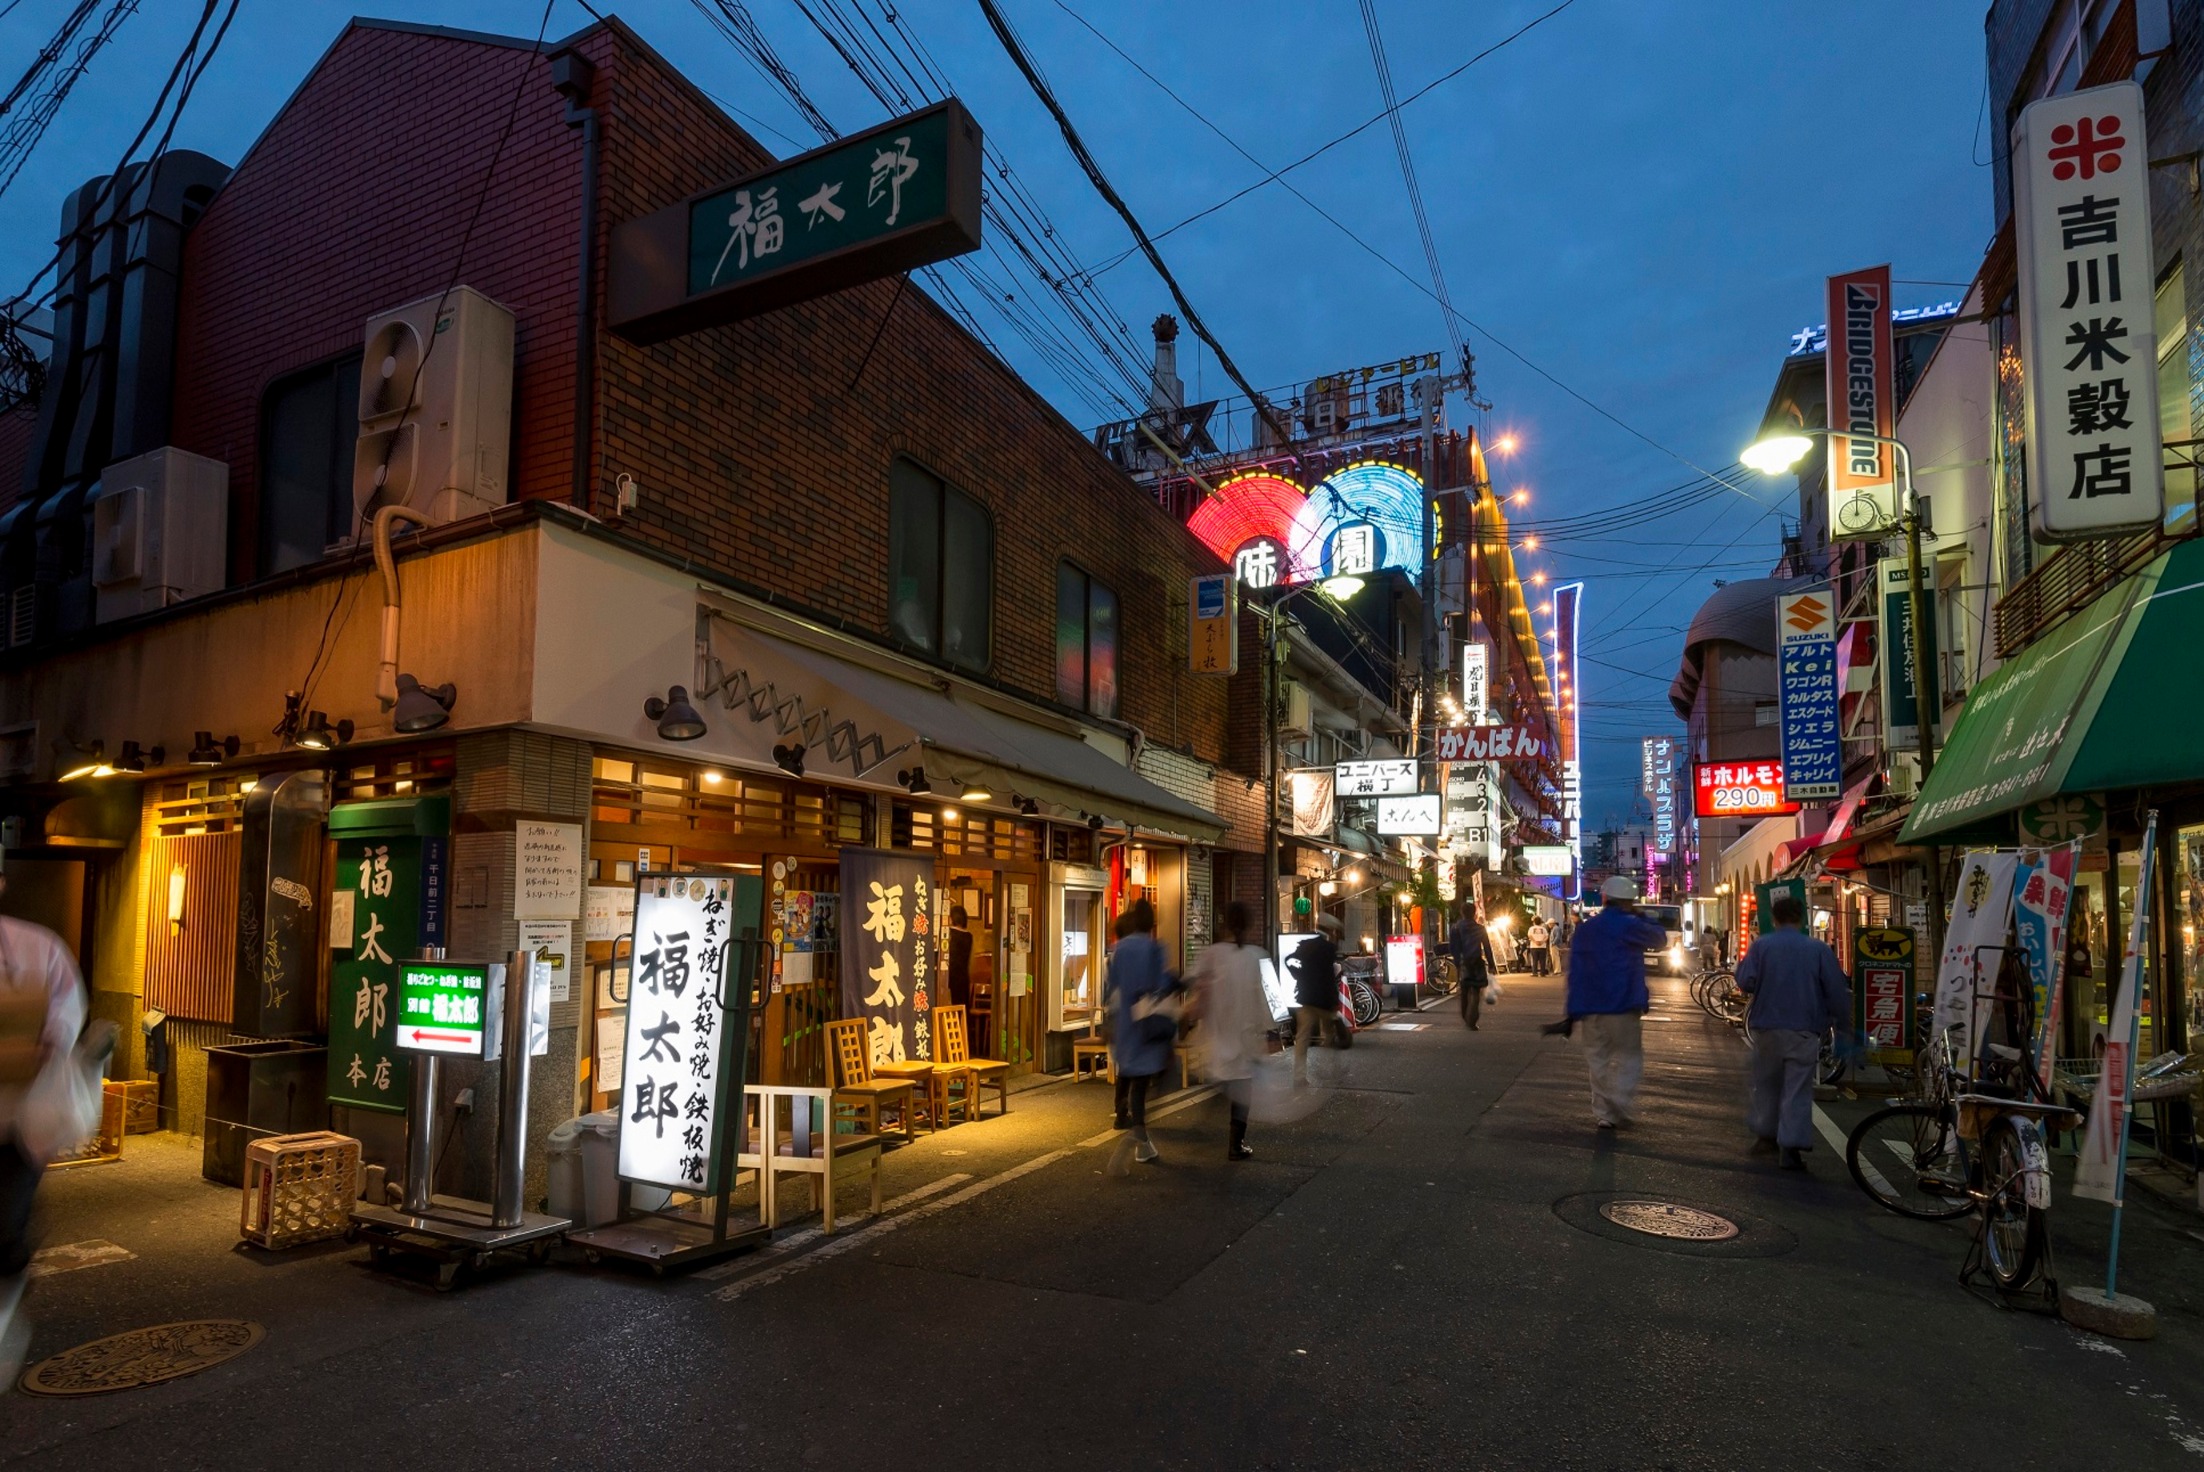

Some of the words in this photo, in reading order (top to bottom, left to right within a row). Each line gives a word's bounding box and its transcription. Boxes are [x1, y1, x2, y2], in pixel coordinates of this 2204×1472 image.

[711, 137, 919, 287] 福太郎
[2057, 195, 2133, 500] 吉川米穀店
[1316, 352, 1440, 393] レジャービル
[1847, 282, 1881, 477] BRIDGESTONE
[1891, 569, 1928, 581] MSD
[1786, 632, 1829, 643] SUZUKI
[1785, 643, 1832, 658] アルト
[1785, 659, 1832, 674] Kei
[1786, 674, 1833, 689] ワゴンR
[1787, 690, 1834, 704] カルタス
[1788, 705, 1834, 719] エスクード
[1788, 721, 1835, 736] シエラ
[1440, 727, 1540, 759] かんばん
[1789, 738, 1836, 751] ジムニー
[1339, 763, 1413, 778] ユニバース
[1476, 768, 1486, 782] 4
[1356, 778, 1396, 792] 横丁
[1477, 783, 1487, 798] 3
[1790, 785, 1837, 795] 三木自動車
[1655, 740, 1674, 850] ナンバプラザ
[1714, 787, 1775, 807] 290円
[1477, 798, 1487, 812] 2
[1482, 813, 1487, 827] 1
[1469, 828, 1488, 842] B1
[426, 864, 439, 932] 千日前二丁目
[354, 845, 393, 1039] 福太郎
[2019, 922, 2046, 983] おいしい
[912, 875, 930, 1062] ねぎ焼・お好み焼・鉄板
[1858, 960, 1912, 969] クロネコヤマトの
[863, 881, 906, 1075] 福太郎
[432, 994, 479, 1024] 福太郎
[1870, 972, 1900, 1046] 宅急便
[631, 930, 690, 1140] 福太郎
[346, 1053, 393, 1091] 本店
